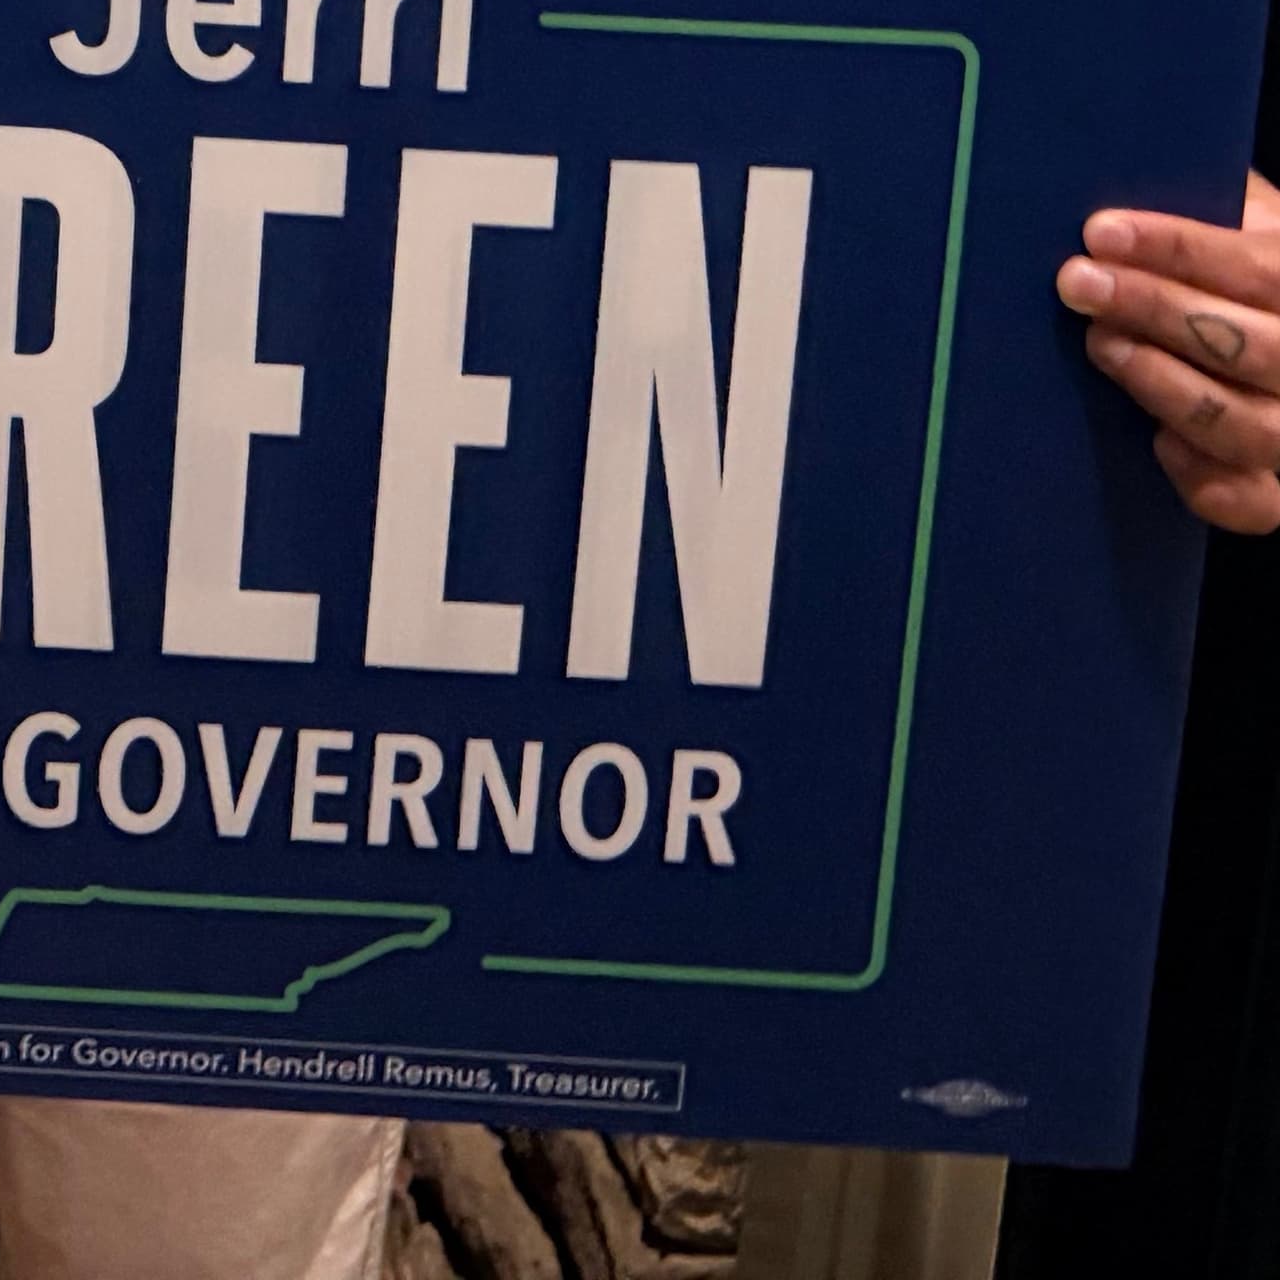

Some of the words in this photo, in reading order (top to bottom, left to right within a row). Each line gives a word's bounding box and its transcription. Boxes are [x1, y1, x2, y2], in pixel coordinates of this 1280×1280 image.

[3, 712, 741, 864] GOVERNOR
[19, 1034, 61, 1064] for
[71, 1038, 229, 1074] Governor.
[237, 1048, 376, 1082] Hendrell
[382, 1056, 498, 1091] Remus,
[506, 1064, 660, 1101] Treasurer.
